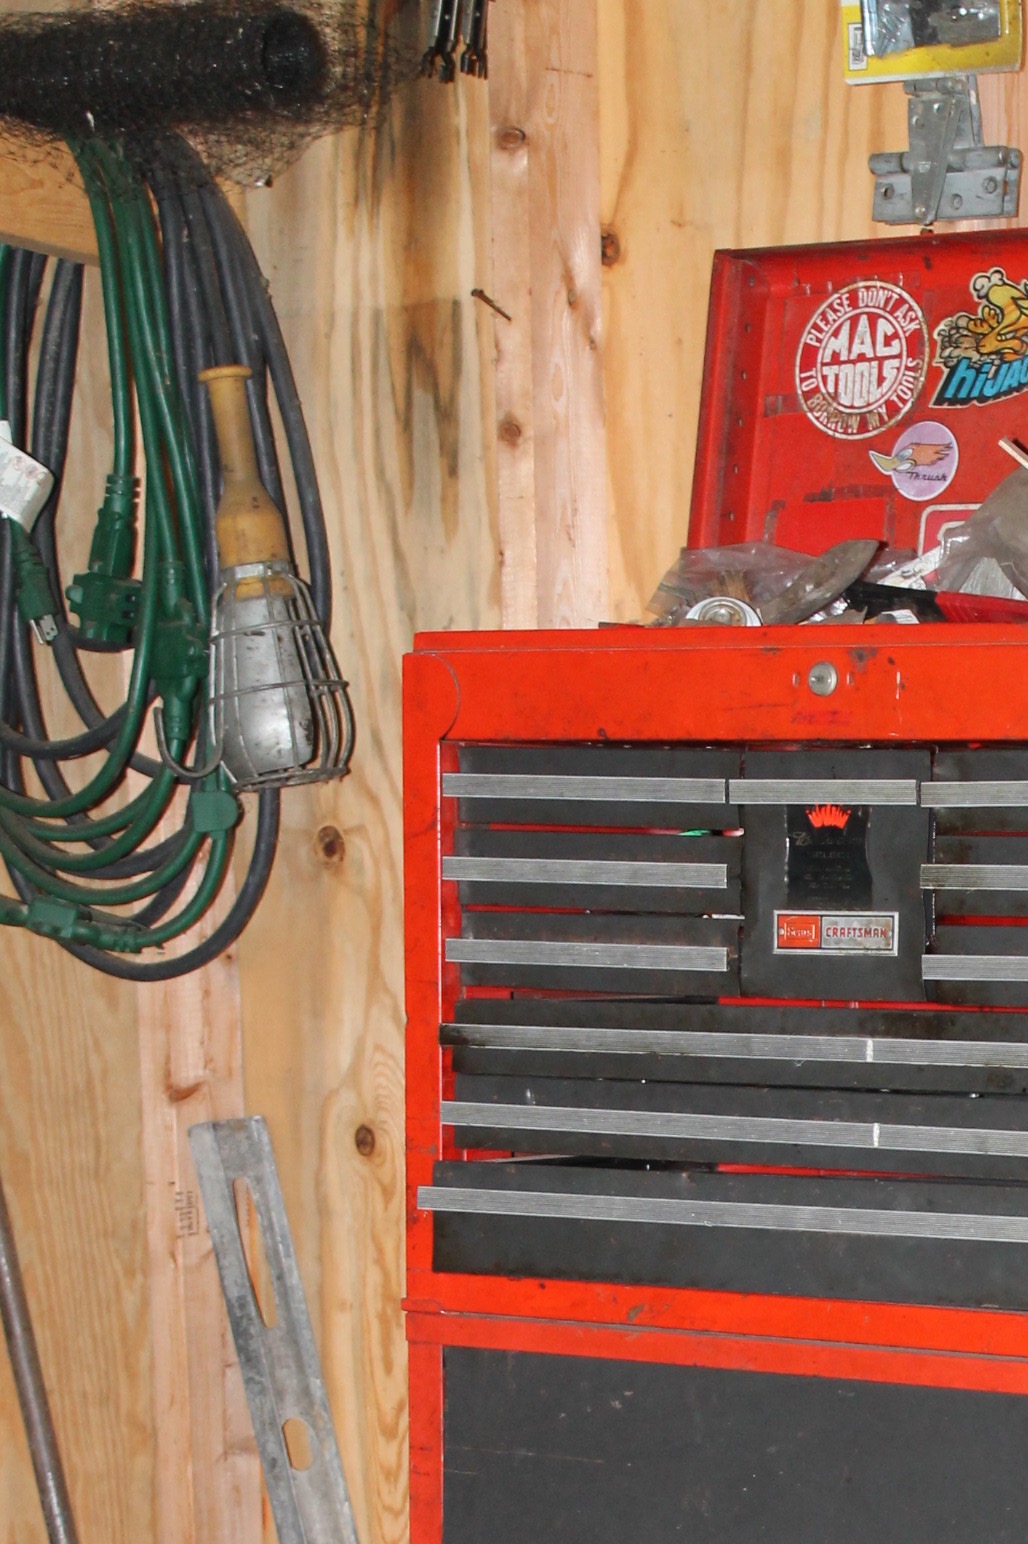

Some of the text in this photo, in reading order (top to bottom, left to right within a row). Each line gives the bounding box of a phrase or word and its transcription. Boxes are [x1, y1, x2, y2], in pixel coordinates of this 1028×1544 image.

[806, 287, 921, 347] PLEASE DON'T ASK
[823, 314, 901, 363] MAC
[800, 368, 818, 392] TO
[890, 357, 923, 409] TOOLS
[822, 358, 901, 407] TOOLS
[825, 926, 887, 939] CRAFTSMAN
